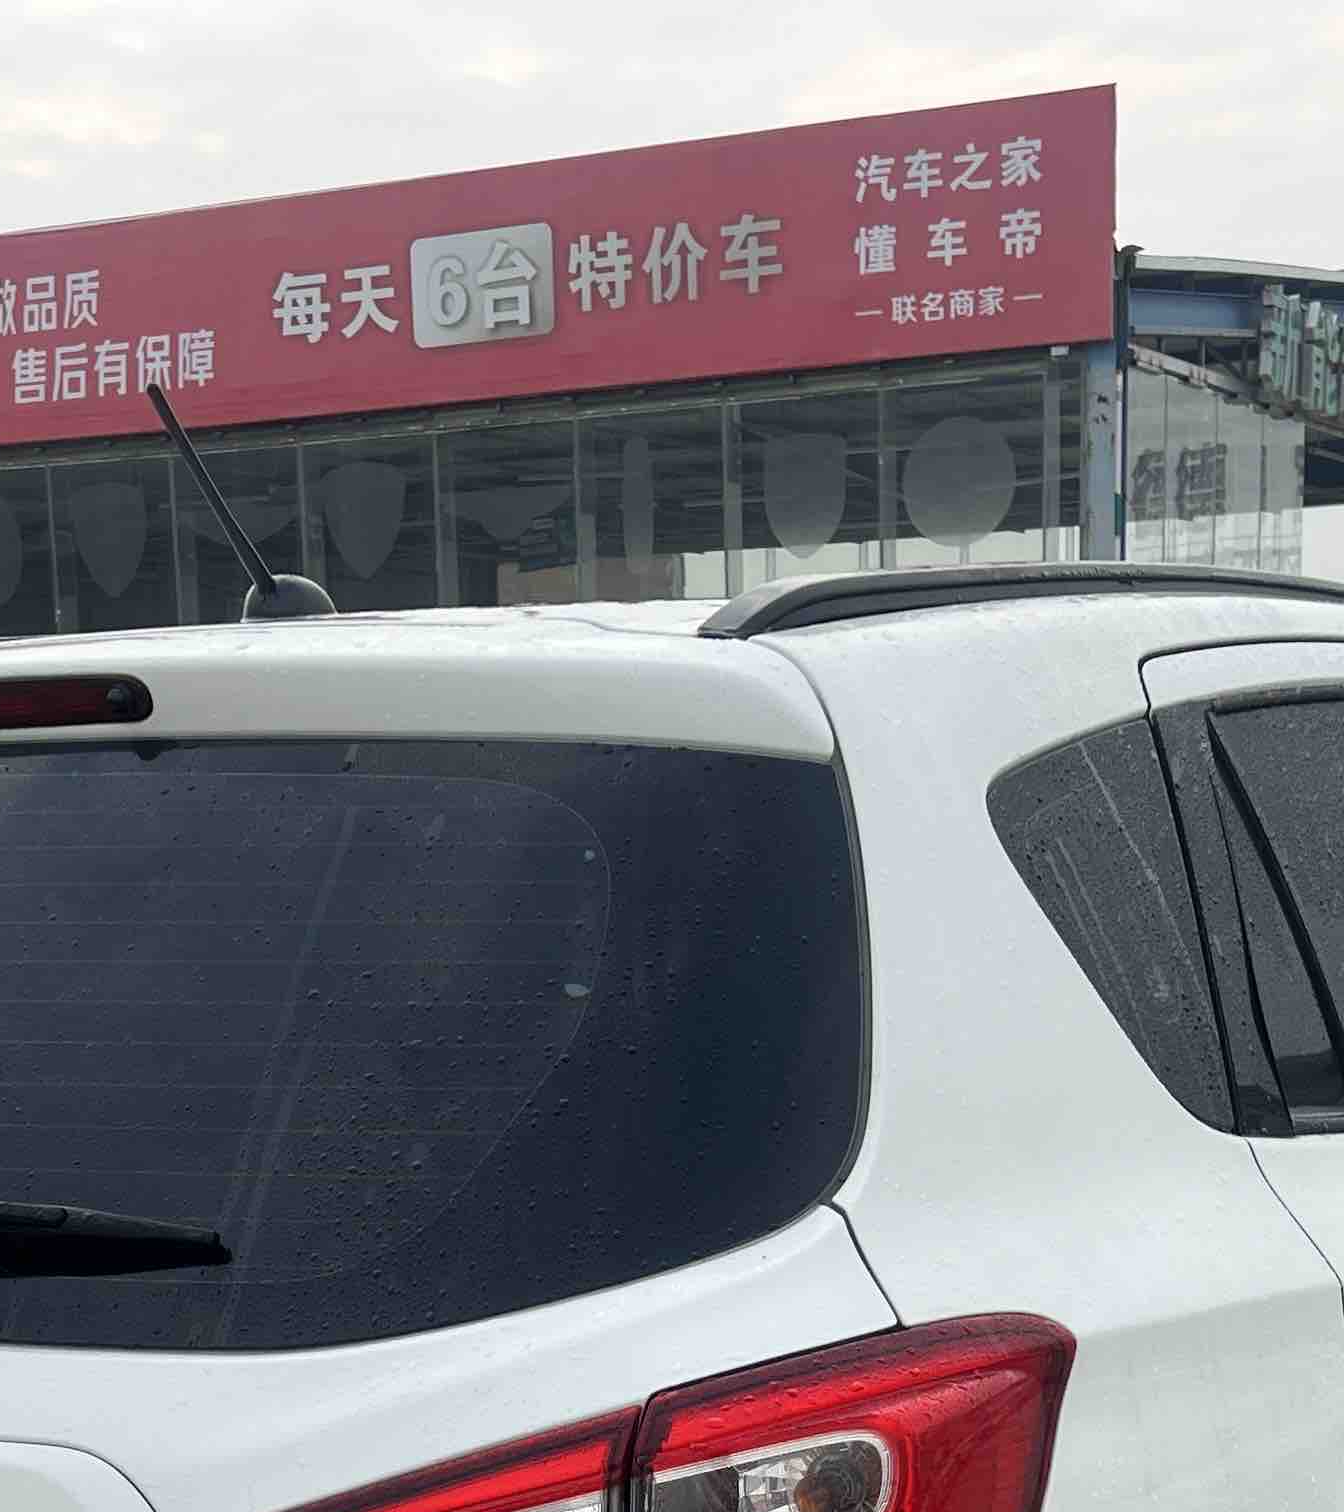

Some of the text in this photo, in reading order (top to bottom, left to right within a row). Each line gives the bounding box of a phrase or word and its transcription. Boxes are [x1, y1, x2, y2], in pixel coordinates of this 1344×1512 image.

[855, 136, 1044, 203] 汽车之家
[855, 207, 1044, 277] 懂车帝
[11, 329, 216, 405] 售后有保障
